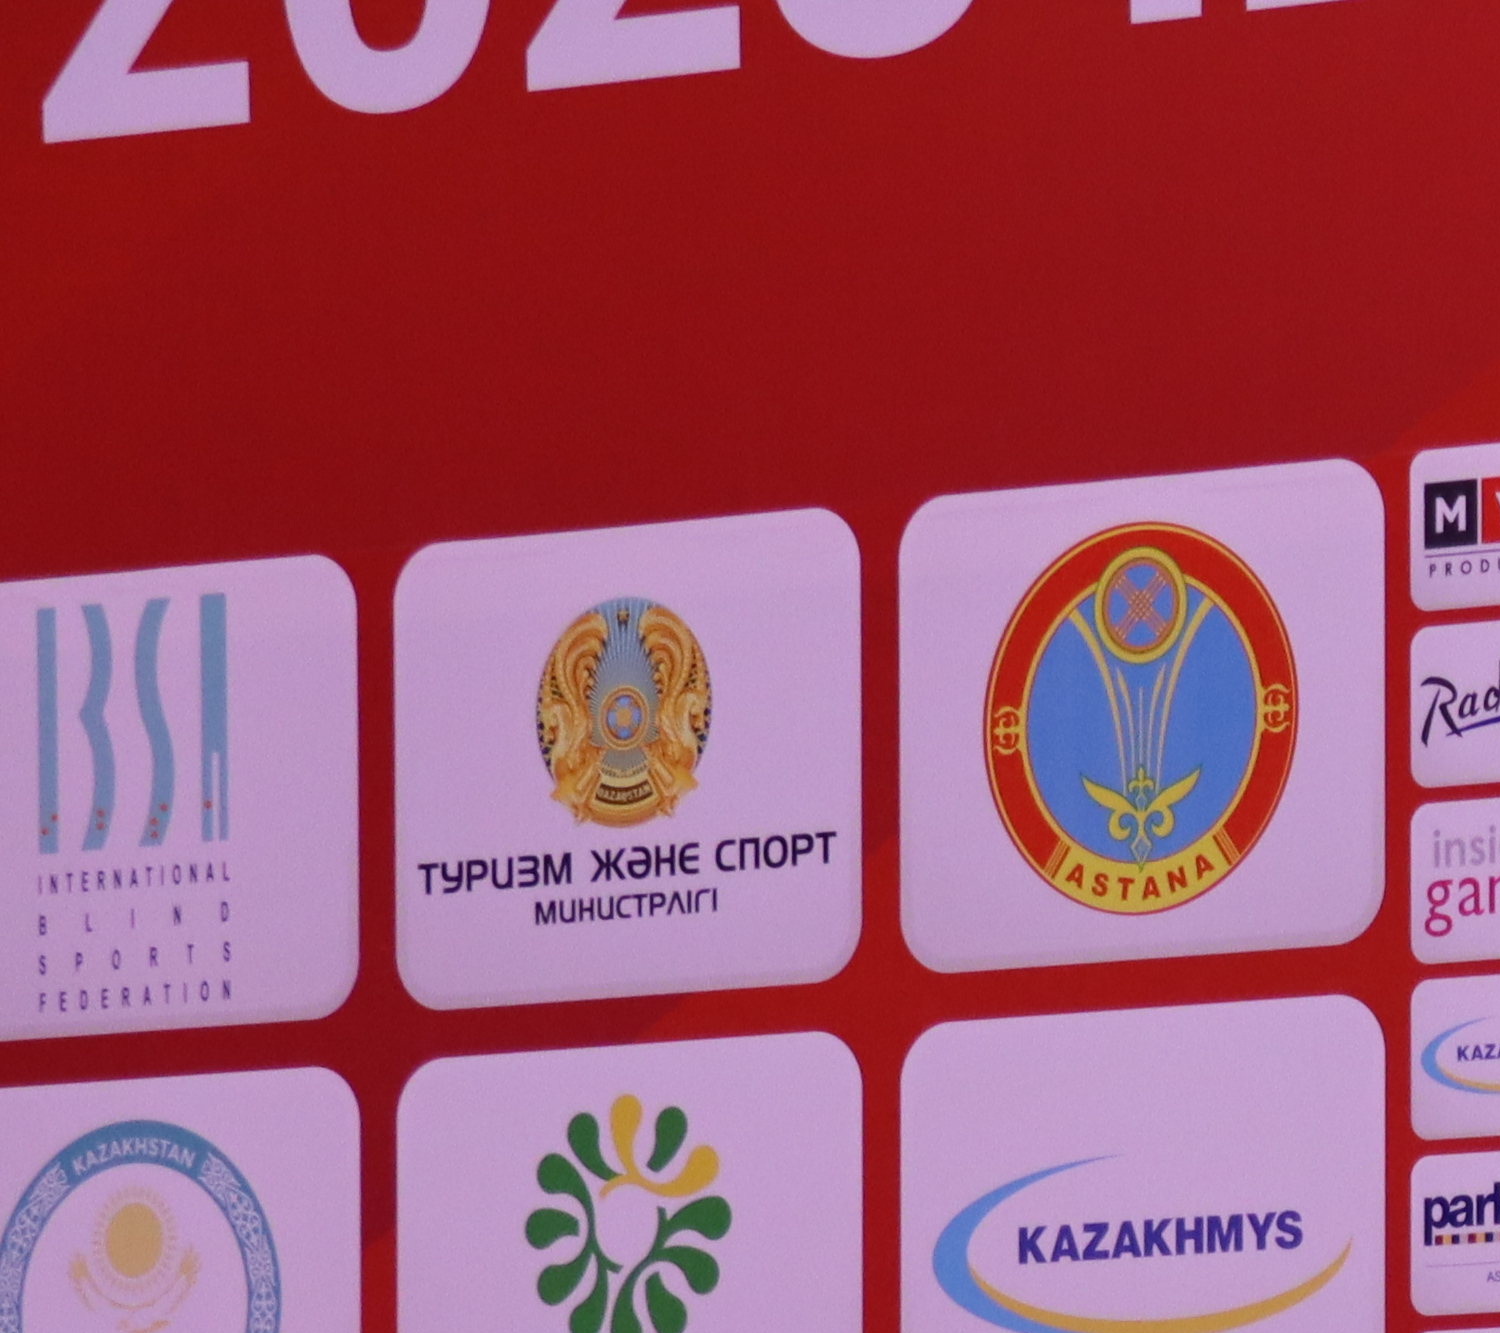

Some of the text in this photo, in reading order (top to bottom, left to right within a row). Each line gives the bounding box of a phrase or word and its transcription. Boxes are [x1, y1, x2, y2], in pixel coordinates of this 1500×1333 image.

[38, 861, 230, 895] INTERNATIONAL
[417, 851, 574, 896] ТУРИЗМ
[715, 831, 838, 873] СПОРТ
[1065, 852, 1218, 904] ASTANA
[39, 901, 229, 936] BLIND
[39, 940, 231, 976] SPORTS
[39, 980, 231, 1013] FEDERATION
[71, 1137, 198, 1176] KAZAKHSTAN
[1016, 1211, 1305, 1265] KAZAKHMYS
